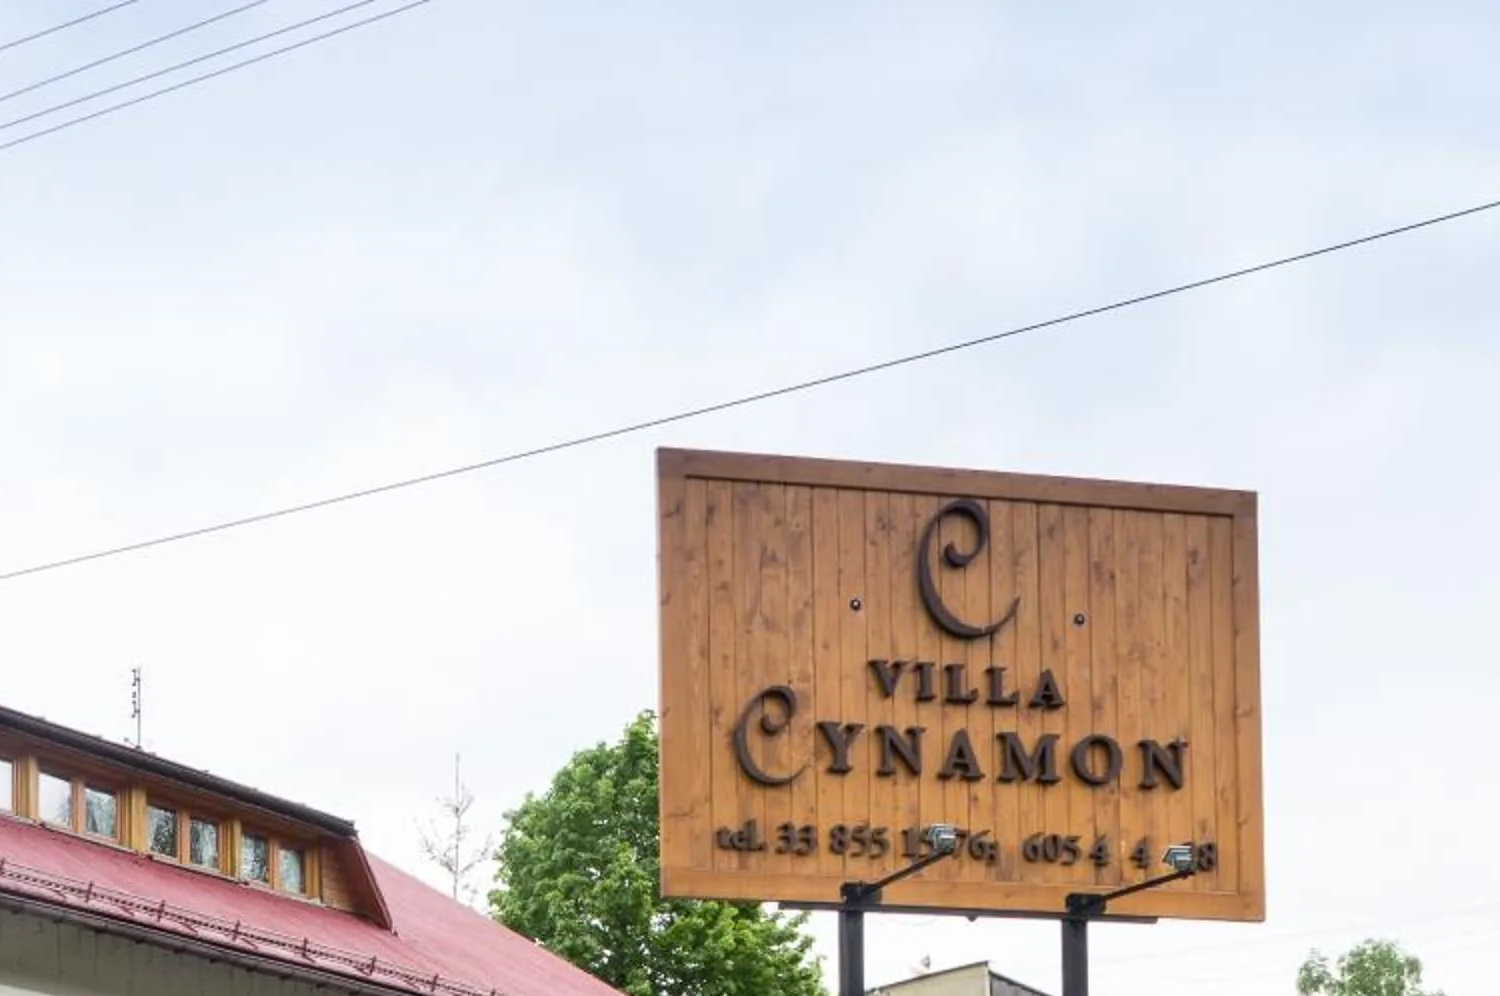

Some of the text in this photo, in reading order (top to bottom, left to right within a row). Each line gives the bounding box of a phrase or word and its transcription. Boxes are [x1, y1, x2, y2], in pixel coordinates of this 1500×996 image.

[868, 659, 1064, 709] VILLA
[734, 684, 1188, 790] CYNAMON
[716, 818, 768, 852] tel.
[775, 821, 818, 857] 33
[829, 823, 890, 860] 855
[1023, 829, 1082, 866] 605
